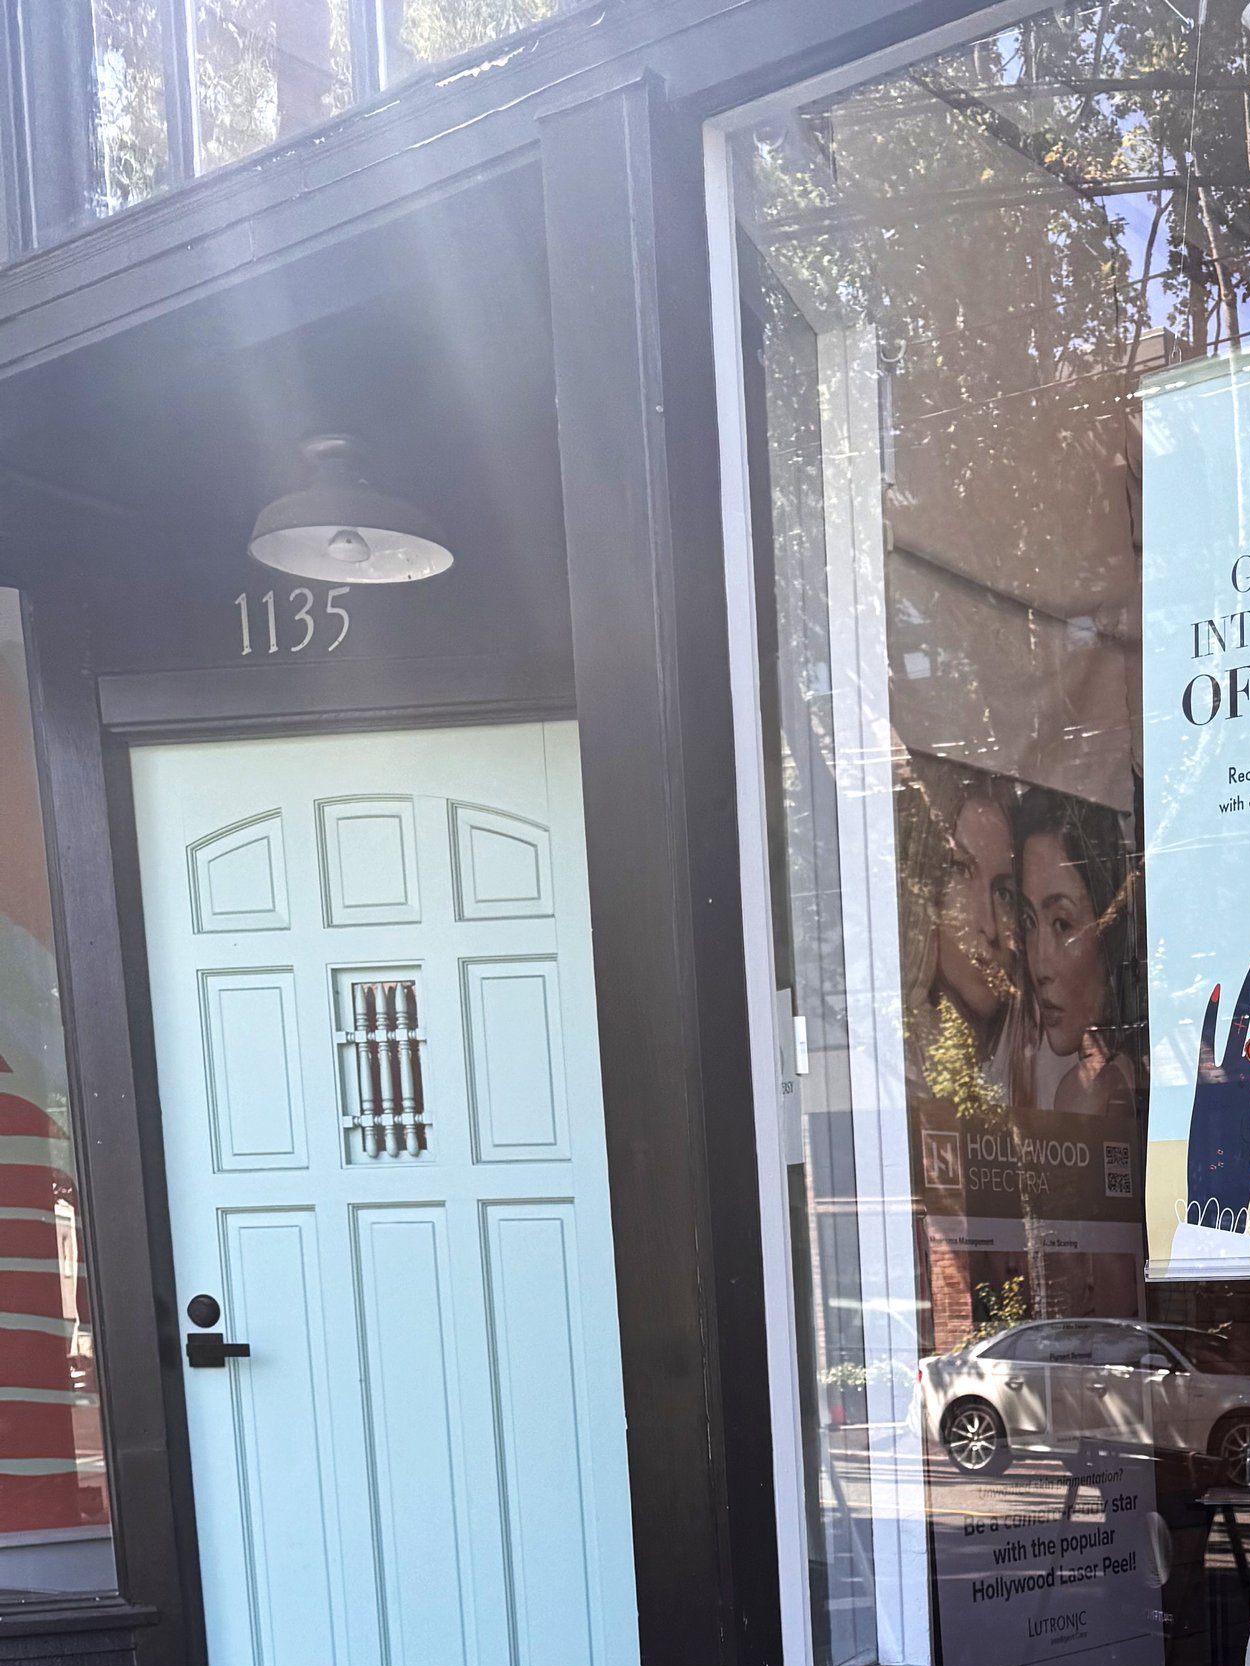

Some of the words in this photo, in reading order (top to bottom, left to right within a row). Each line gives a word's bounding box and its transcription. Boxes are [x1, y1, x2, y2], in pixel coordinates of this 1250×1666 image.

[235, 586, 350, 656] 1135
[1219, 795, 1244, 814] with
[967, 1133, 1090, 1168] HOLLYWOOD
[969, 1168, 1050, 1194] SPECTRA
[1057, 1468, 1123, 1492] pigmentation?
[964, 1514, 984, 1537] Be
[990, 1517, 999, 1532] a
[1112, 1493, 1138, 1513] star
[993, 1539, 1027, 1565] with
[1032, 1537, 1056, 1559] the
[1060, 1528, 1116, 1559] popular
[972, 1566, 1055, 1602] Hollywood
[1060, 1564, 1099, 1585] Laser
[1103, 1552, 1137, 1576] Peel!
